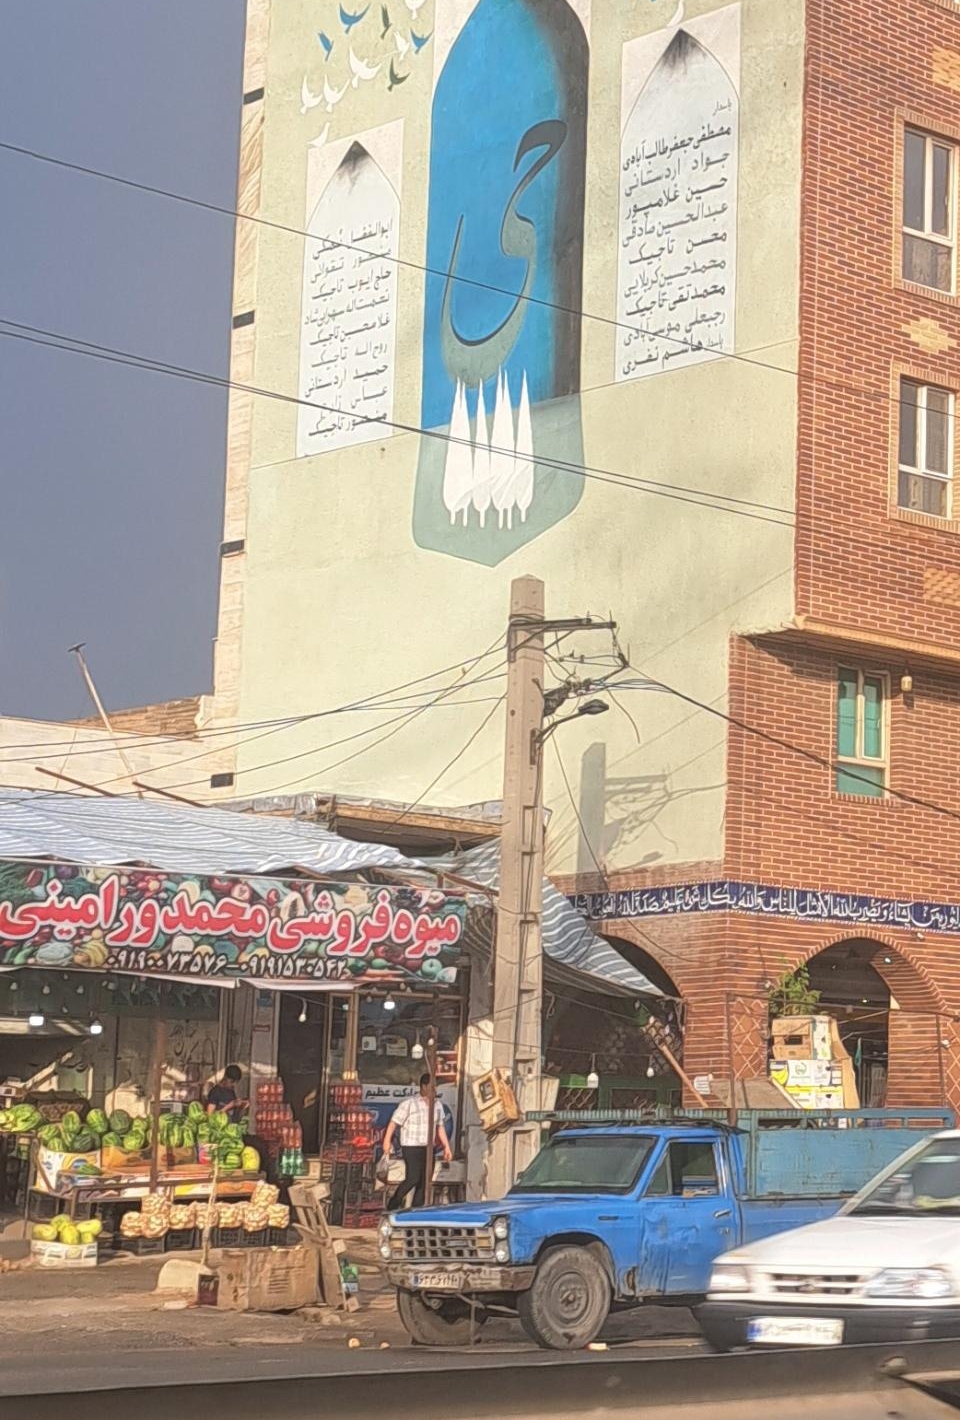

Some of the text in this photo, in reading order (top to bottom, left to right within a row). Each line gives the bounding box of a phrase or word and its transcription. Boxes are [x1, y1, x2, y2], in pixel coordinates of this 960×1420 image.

[624, 151, 730, 198] جواد اردستانی
[685, 177, 729, 203] حسین
[628, 231, 728, 266] محسن تاجیک
[0, 874, 461, 959] میوه فروشی محمد ورامینی
[365, 1086, 390, 1099] عظیم
